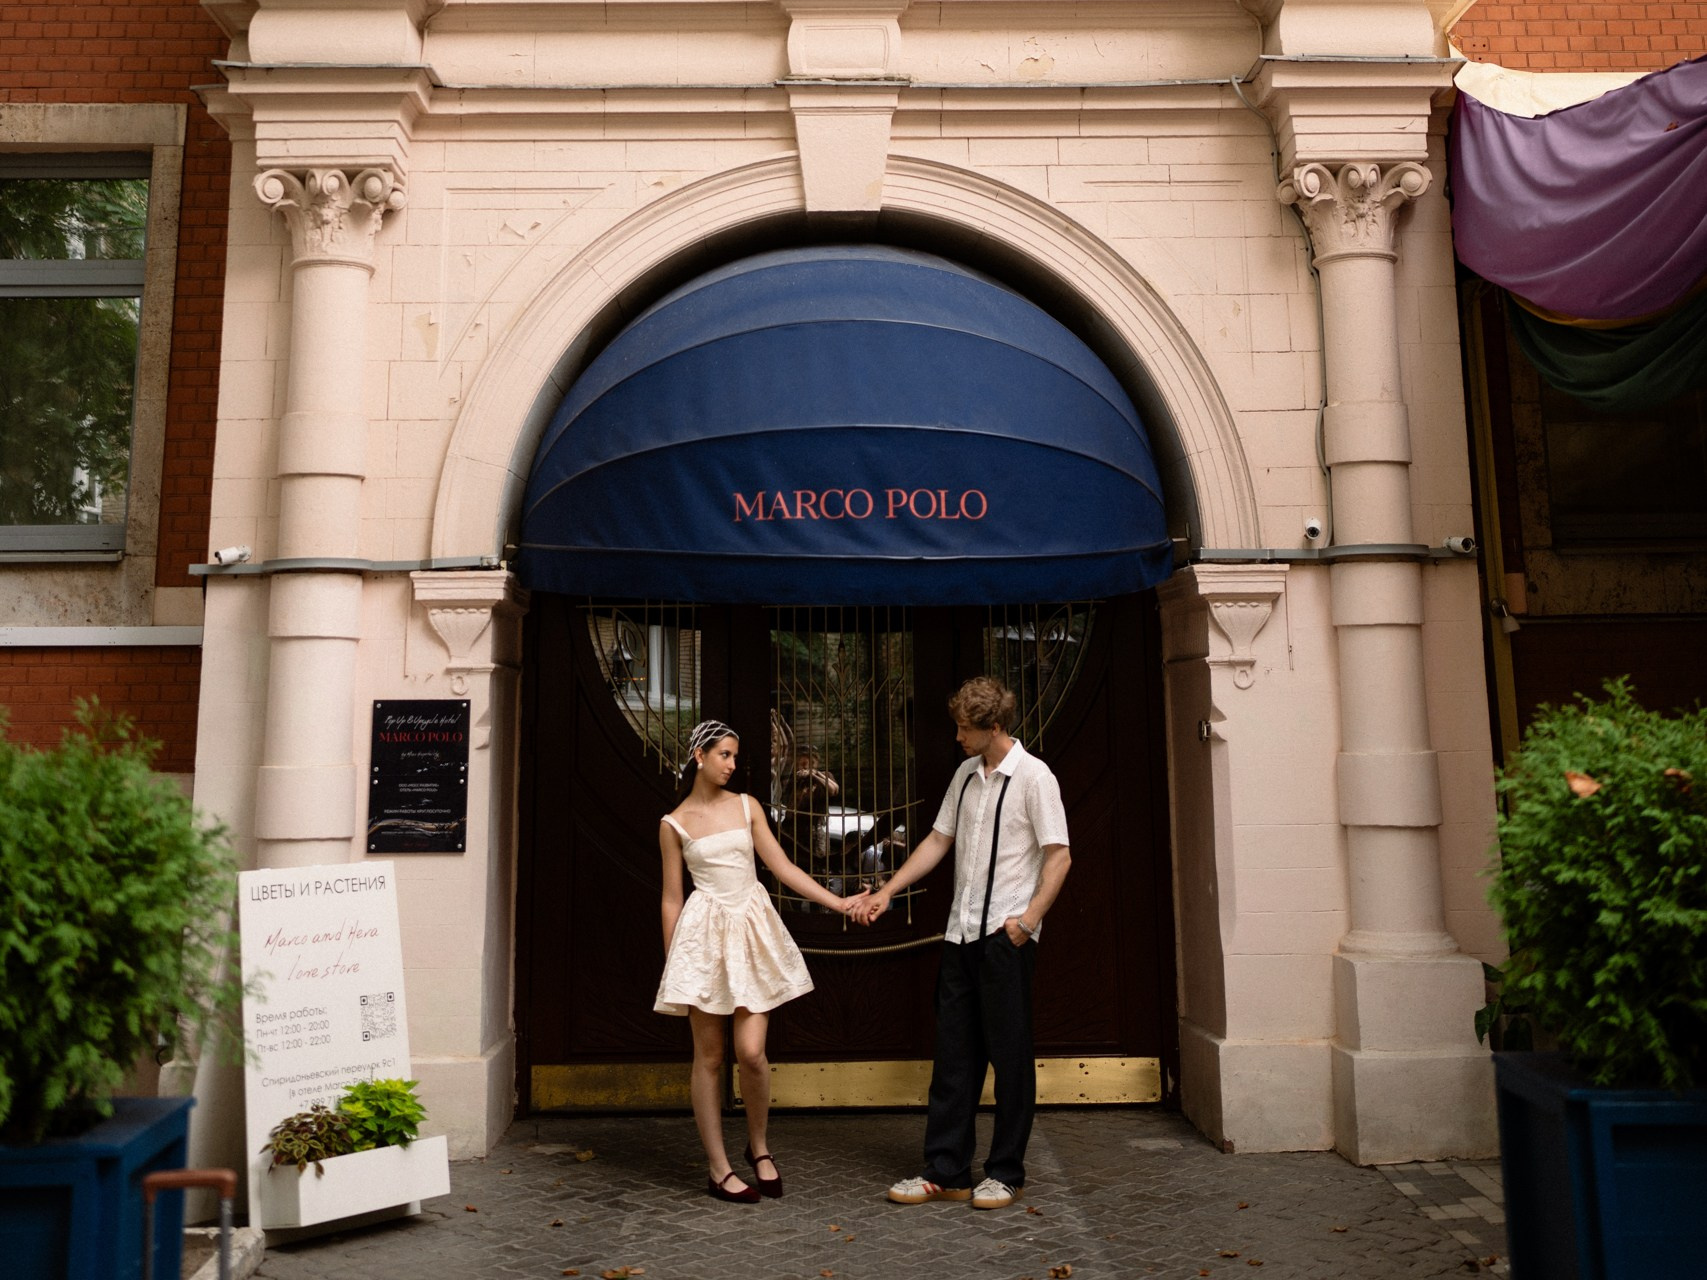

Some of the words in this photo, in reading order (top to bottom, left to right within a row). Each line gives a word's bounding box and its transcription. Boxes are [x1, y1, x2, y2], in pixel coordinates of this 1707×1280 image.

[733, 488, 874, 521] MARCO
[884, 488, 988, 520] POLO
[438, 713, 462, 727] Hotel
[379, 732, 427, 742] MARCO
[428, 731, 464, 742] POLO
[251, 883, 296, 902] ЦВЕТЫ
[300, 882, 310, 896] И
[315, 875, 387, 895] РАСТЕНИЯ
[264, 926, 308, 956] Marco
[311, 917, 347, 944] and
[320, 951, 360, 980] store
[256, 1011, 287, 1024] Время
[289, 1006, 328, 1021] работы:
[256, 1028, 278, 1038] Пн-чт
[281, 1023, 302, 1035] 12:00
[308, 1020, 330, 1032] 20:00
[257, 1043, 279, 1053] Пт-вс
[281, 1038, 303, 1051] 12:00
[309, 1034, 332, 1046] 22:00
[261, 1066, 340, 1088] Спиридоньевский
[341, 1061, 380, 1076] переулок
[298, 1084, 323, 1097] отеле
